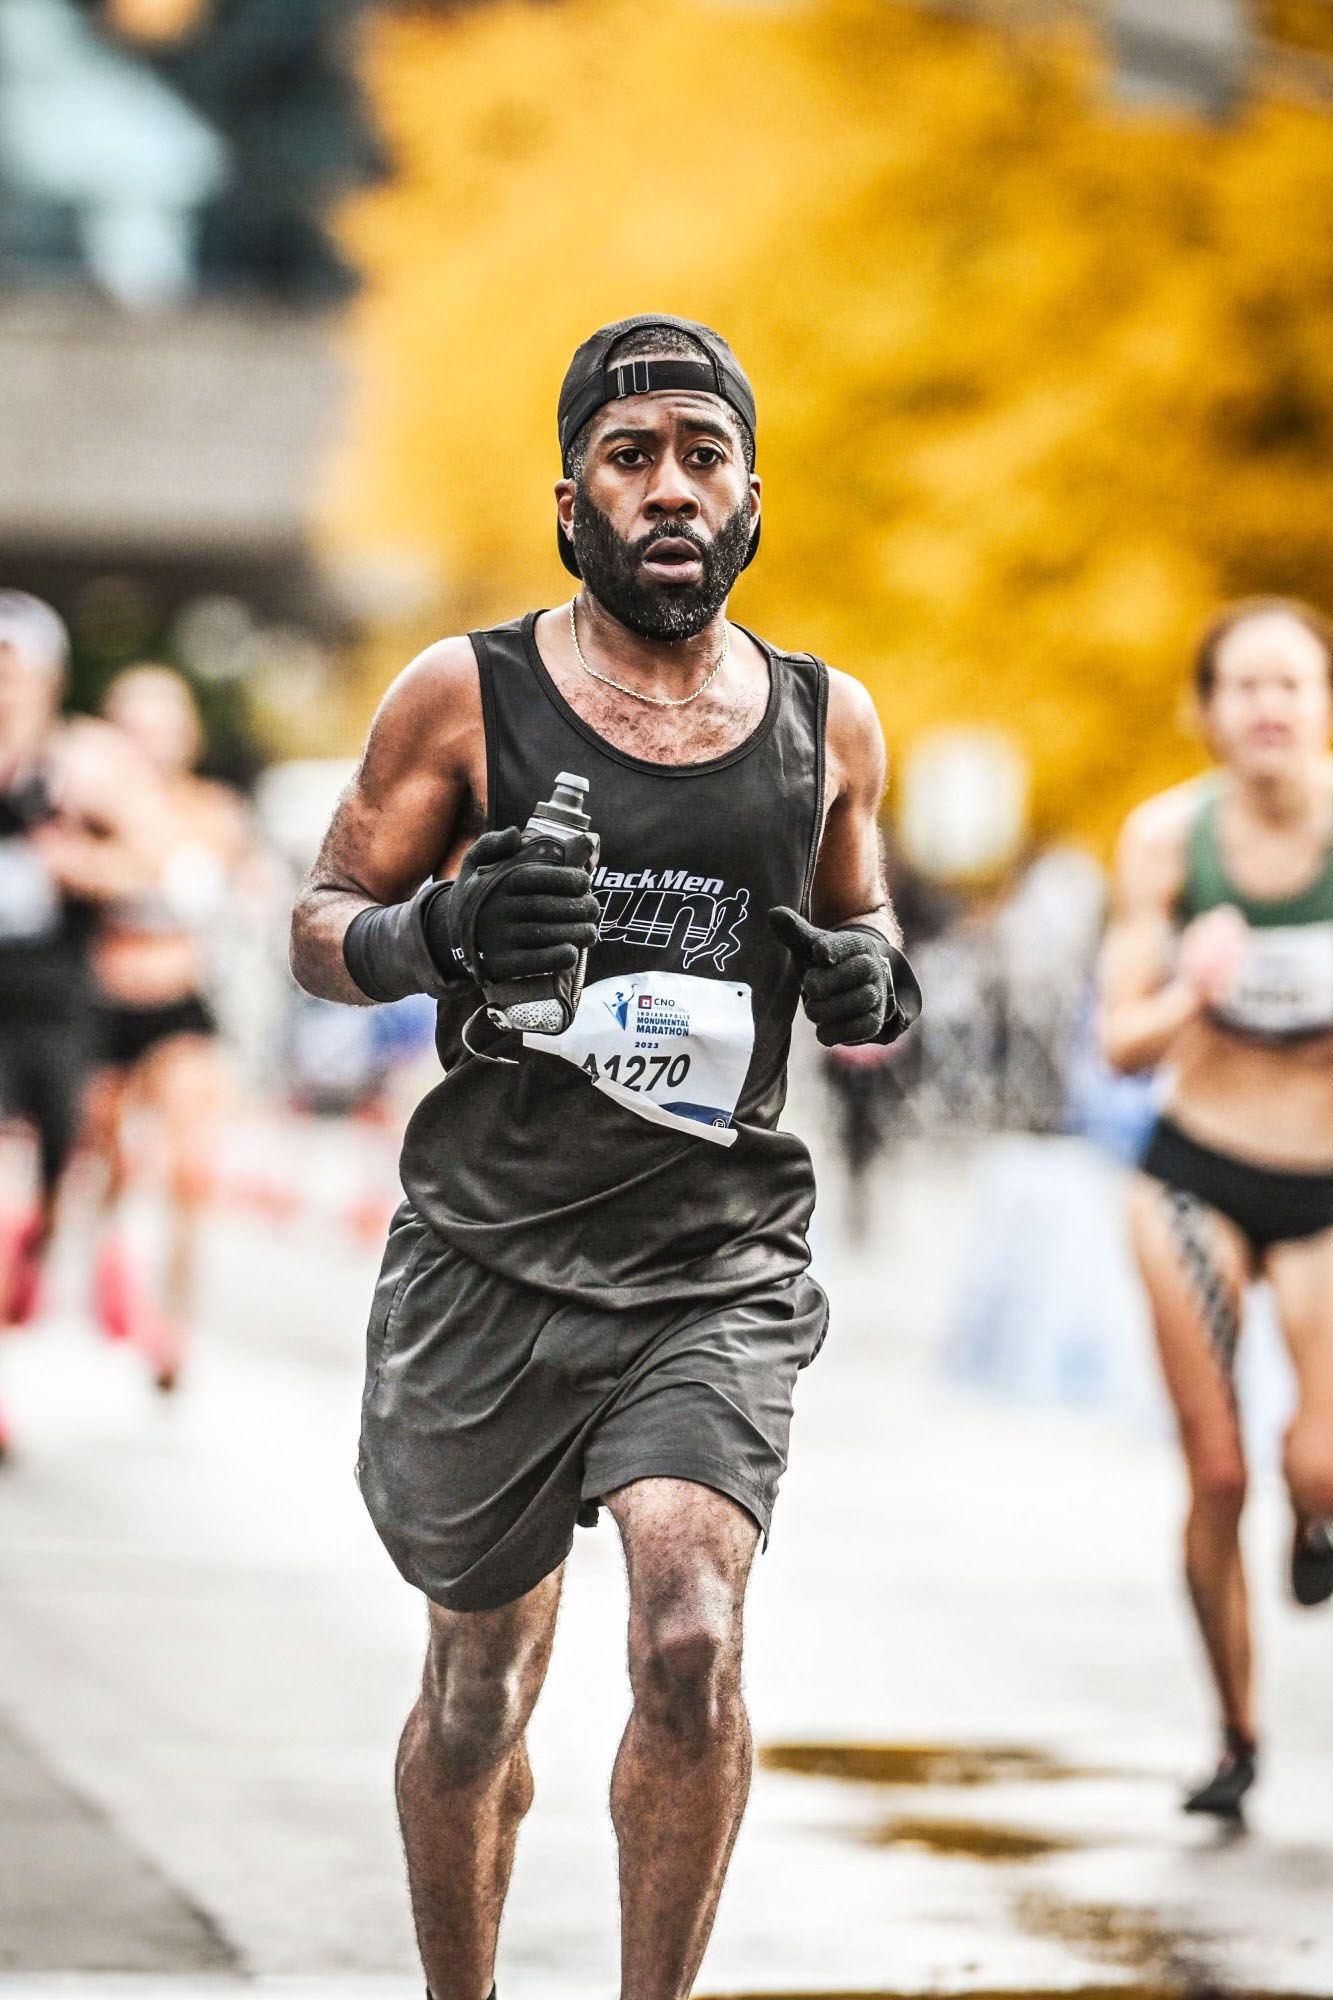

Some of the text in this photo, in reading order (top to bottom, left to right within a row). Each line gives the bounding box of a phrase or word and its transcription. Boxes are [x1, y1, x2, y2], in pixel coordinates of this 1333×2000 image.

[590, 866, 724, 895] lackMen
[590, 889, 717, 950] un
[654, 998, 675, 1007] CNO
[637, 1011, 690, 1019] INDIANAPOLIS
[636, 1017, 689, 1027] MONUMENTAL
[636, 1025, 689, 1036] MARATHON
[634, 1041, 659, 1049] 2023
[582, 1053, 691, 1092] A1270
